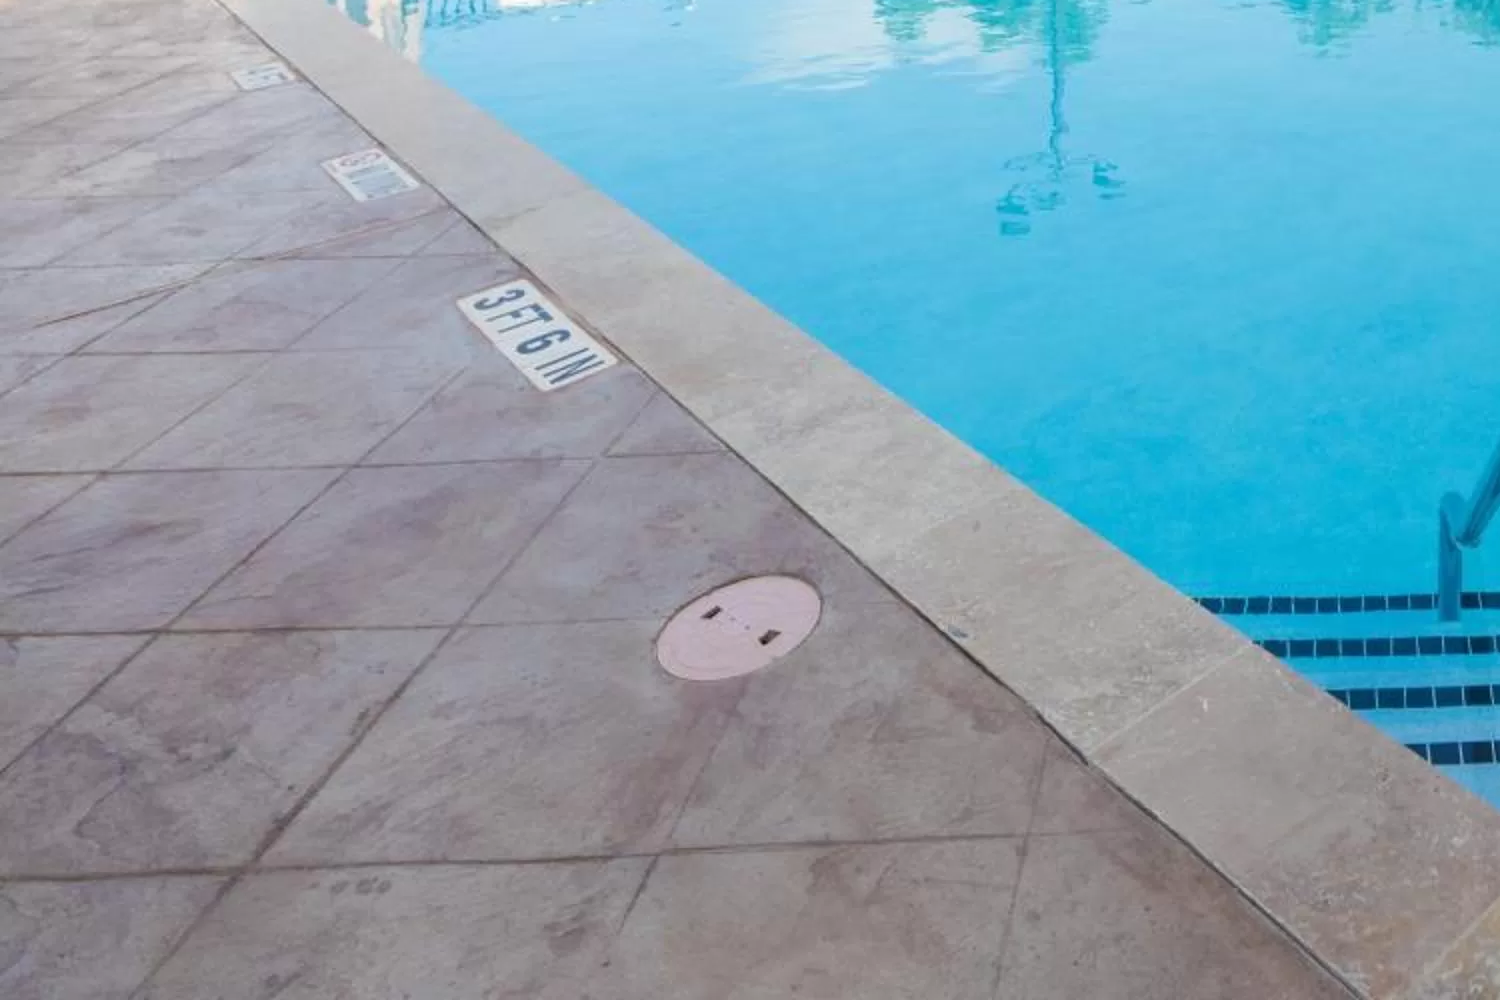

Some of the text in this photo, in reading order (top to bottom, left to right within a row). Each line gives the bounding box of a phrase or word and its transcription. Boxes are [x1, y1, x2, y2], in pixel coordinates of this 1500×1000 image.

[473, 287, 605, 385] 3 FT 6 IN
